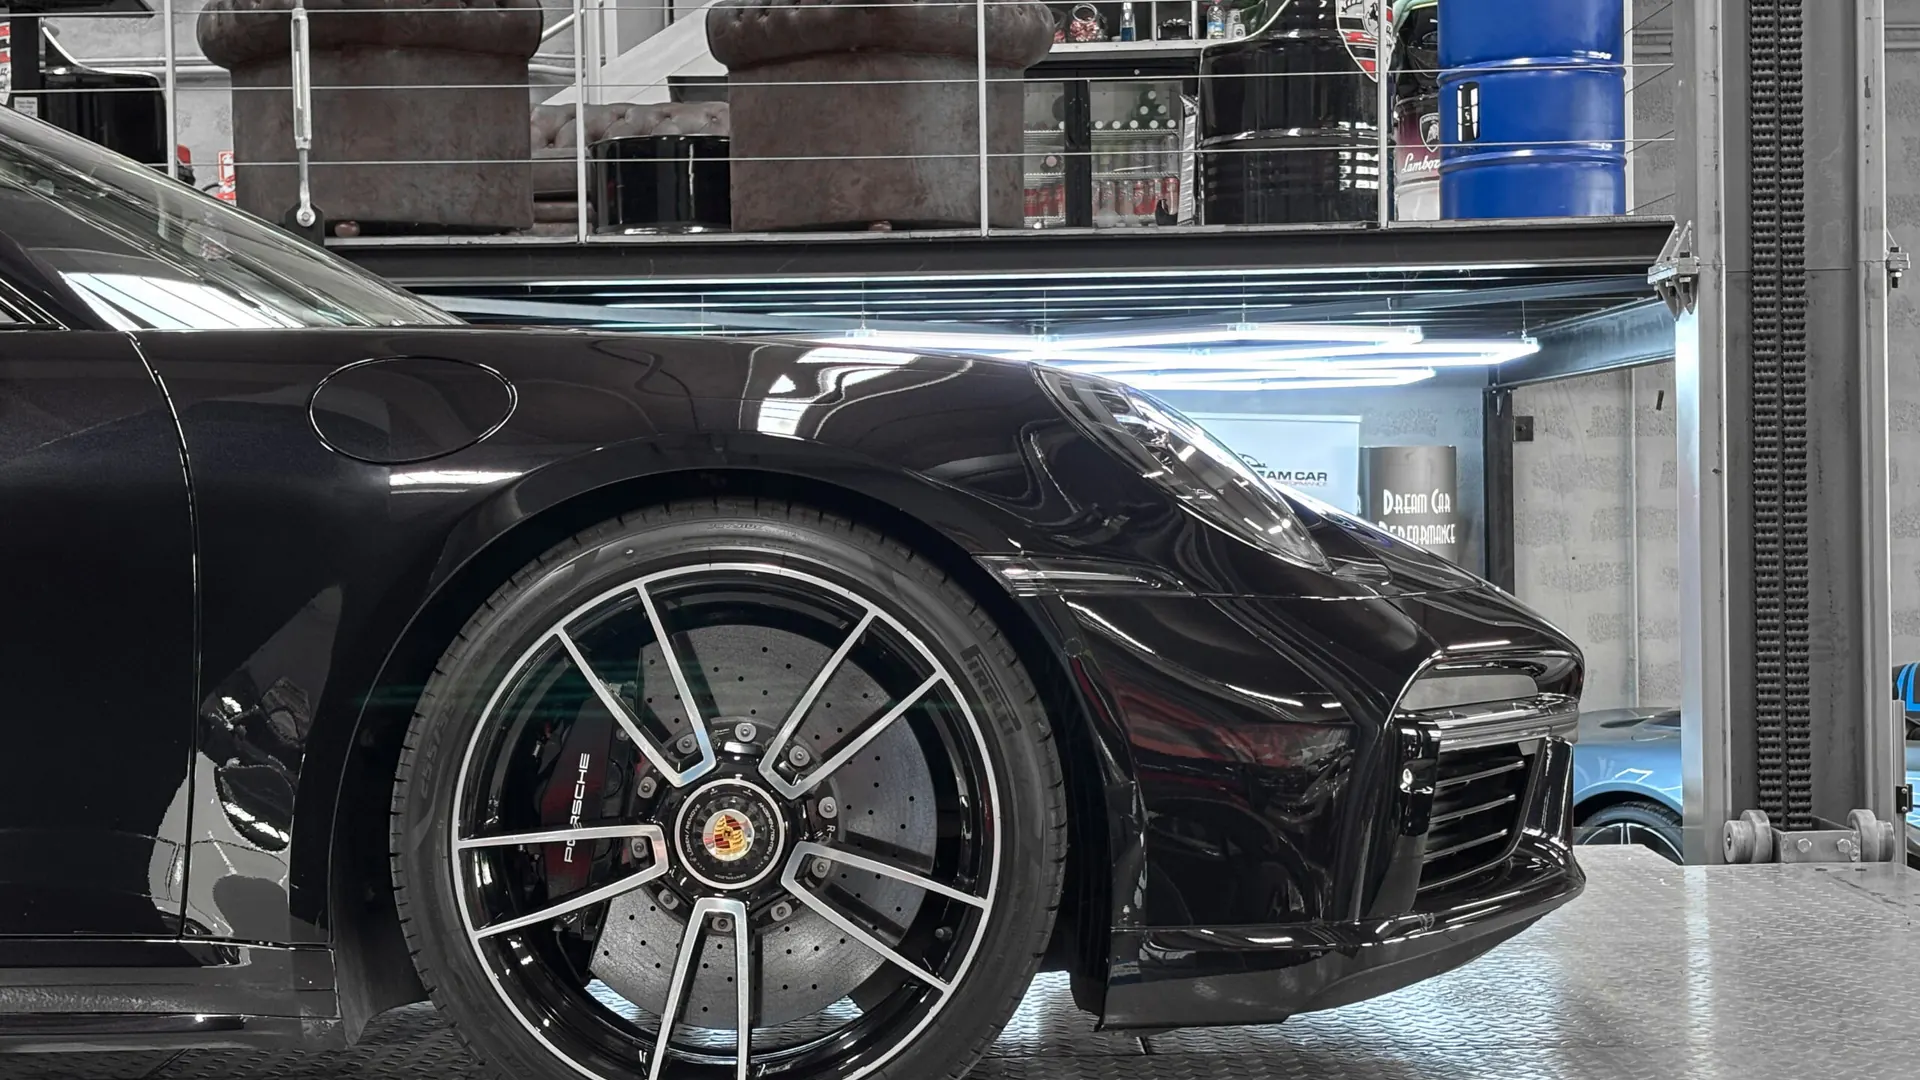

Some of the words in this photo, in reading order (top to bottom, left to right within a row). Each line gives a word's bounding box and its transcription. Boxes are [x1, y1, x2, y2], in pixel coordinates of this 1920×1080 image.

[1294, 471, 1328, 481] CAR
[1383, 489, 1428, 515] DREAM
[1431, 488, 1451, 514] CAR
[960, 644, 1022, 736] PIRELLI
